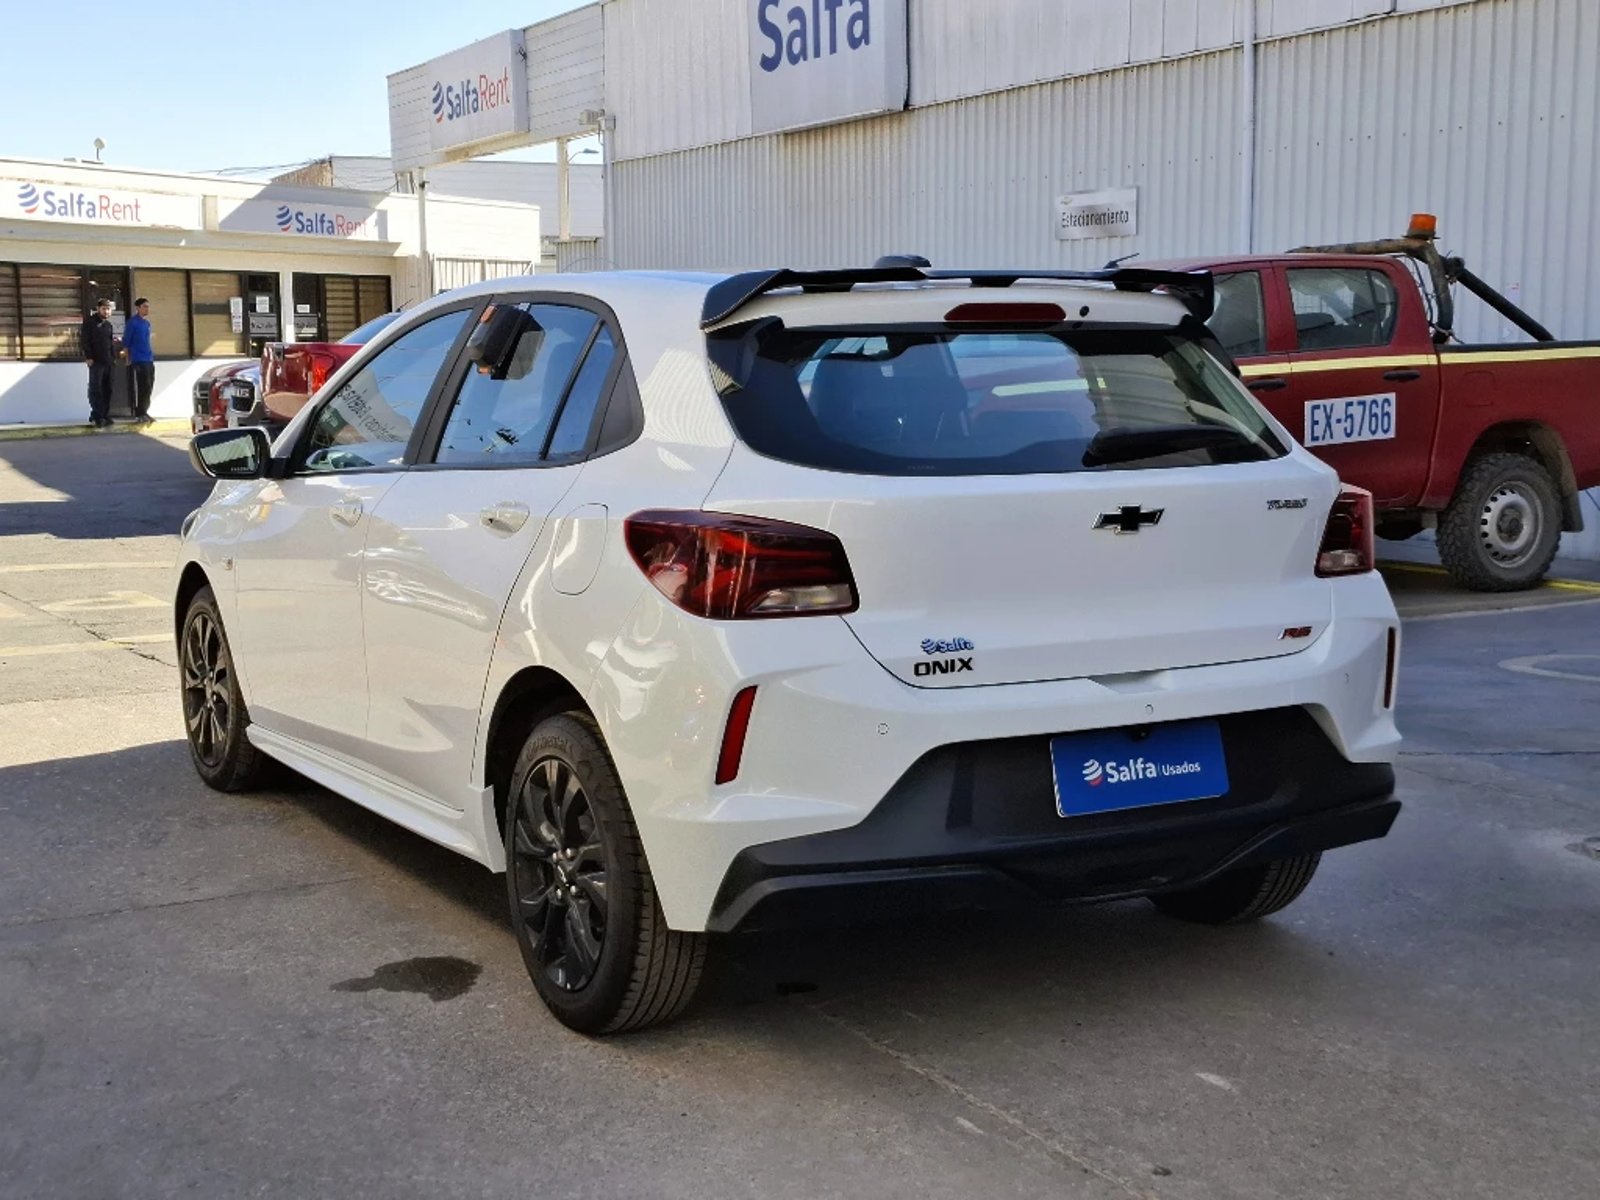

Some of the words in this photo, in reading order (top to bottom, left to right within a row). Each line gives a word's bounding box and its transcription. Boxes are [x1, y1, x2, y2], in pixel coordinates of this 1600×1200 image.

[757, 0, 870, 72] Salfa
[43, 190, 142, 222] SalfaRent
[1062, 208, 1129, 228] Estacionamiento
[1310, 398, 1391, 442] EX-5766
[914, 657, 973, 676] ONIX
[1105, 757, 1157, 783] Salfa
[1162, 761, 1200, 776] Usados
